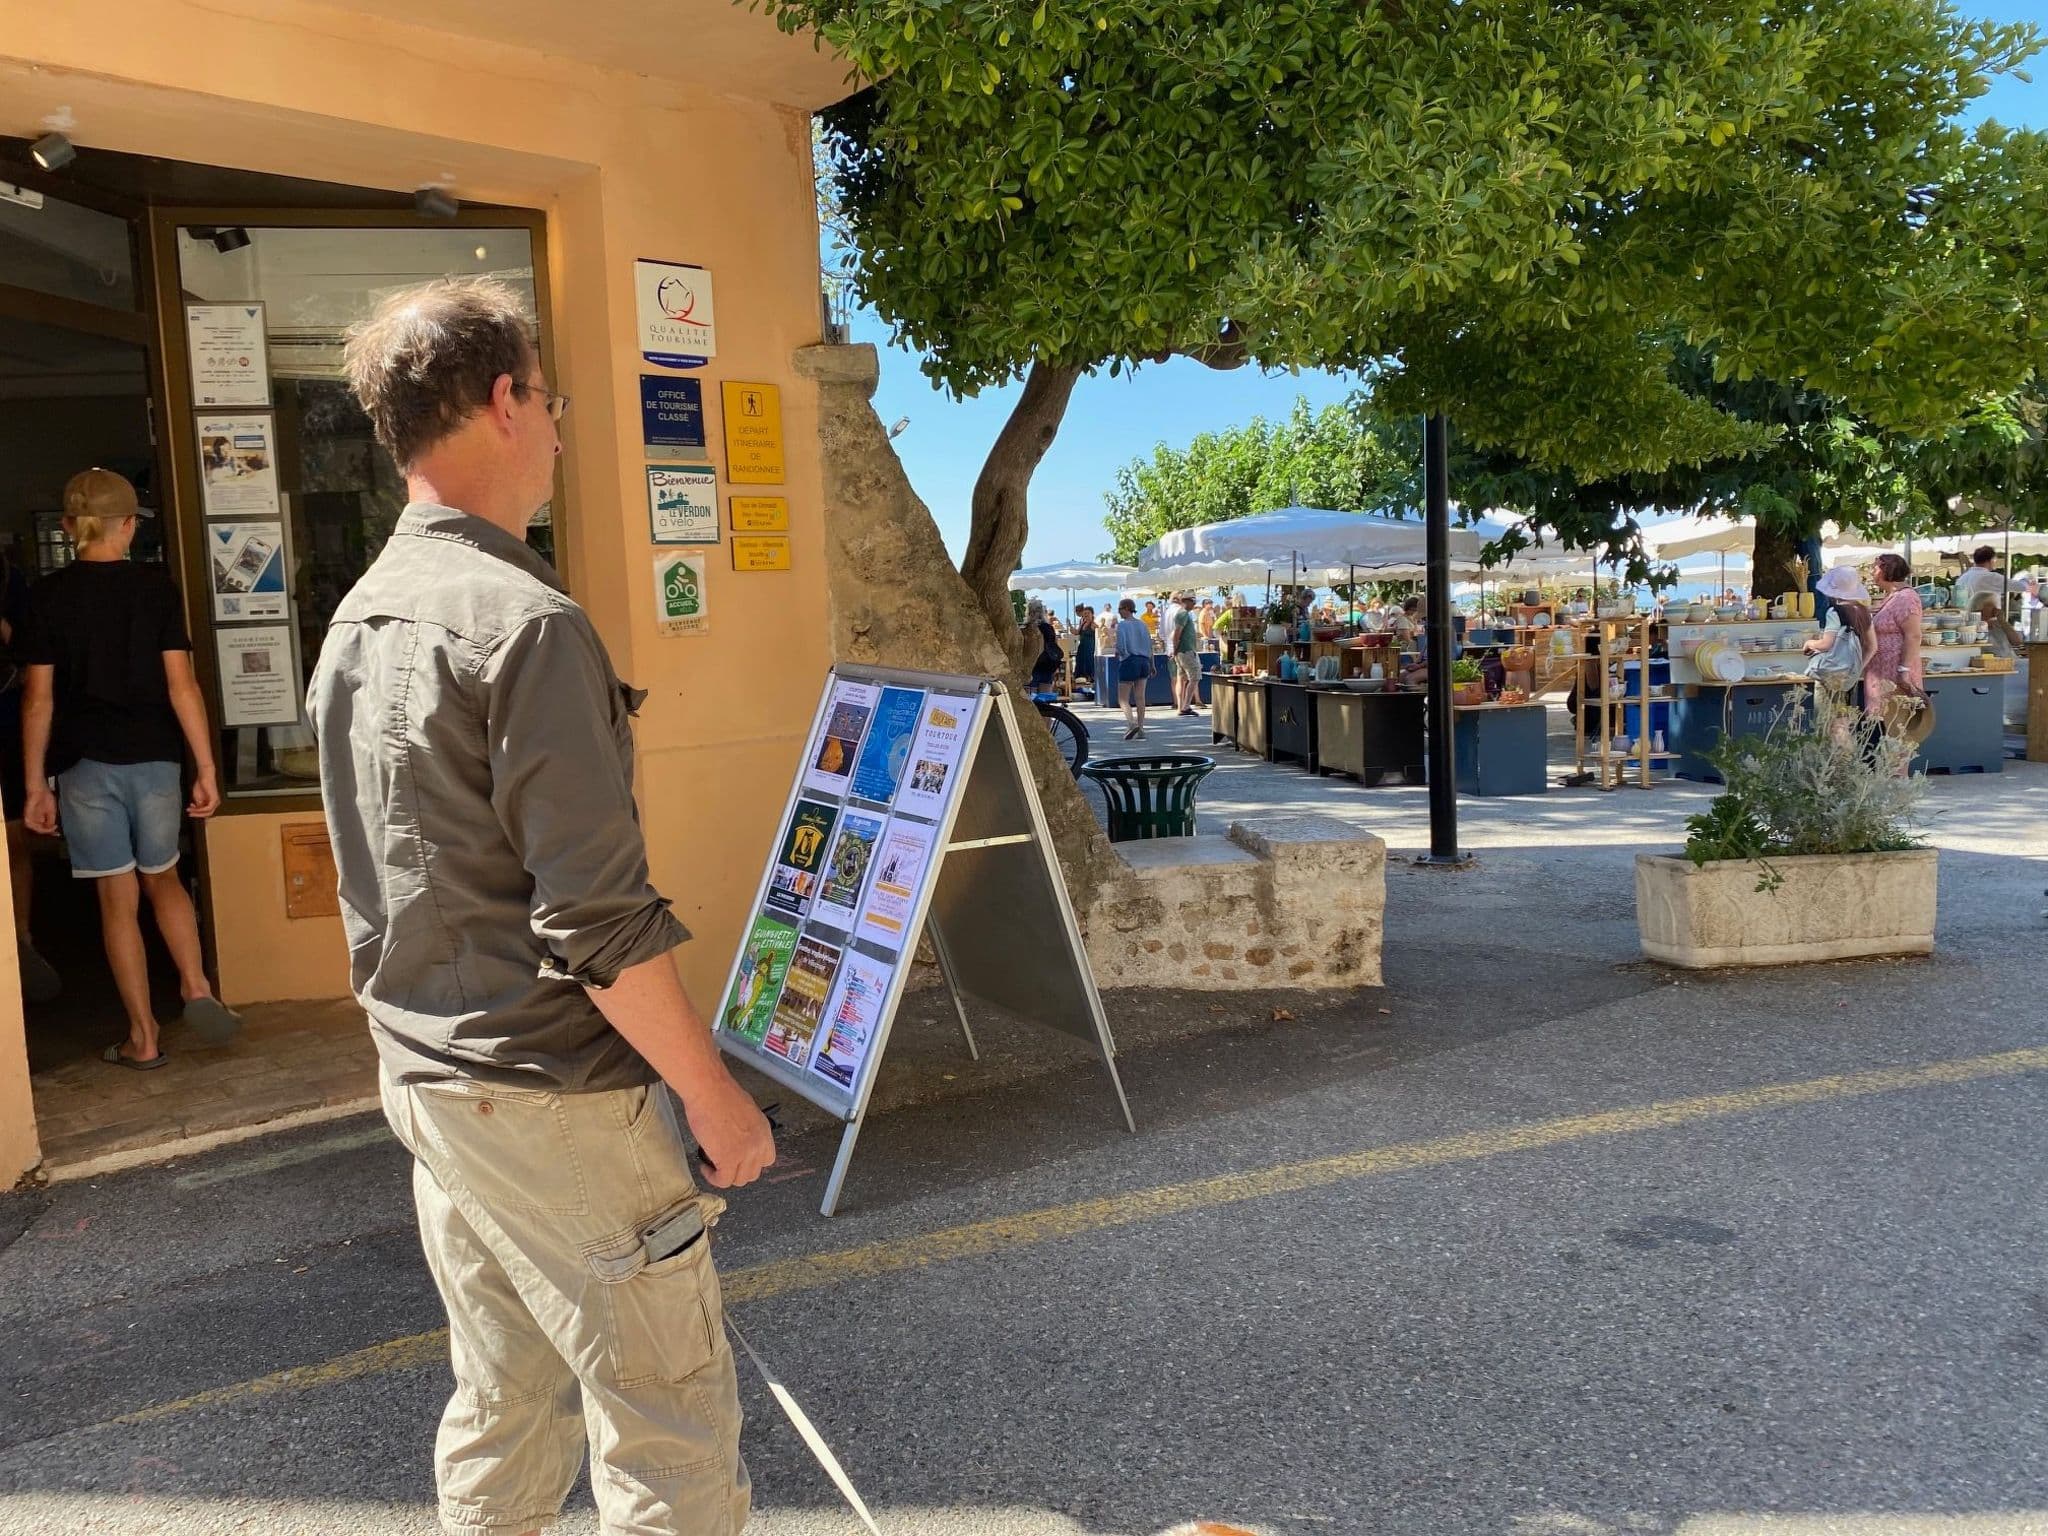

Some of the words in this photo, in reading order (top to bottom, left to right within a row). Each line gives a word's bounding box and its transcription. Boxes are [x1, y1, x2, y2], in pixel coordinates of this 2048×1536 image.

[650, 333, 708, 346] TOURISME
[657, 390, 687, 400] OFFICE
[646, 400, 658, 409] DE
[659, 401, 699, 411] TOURISME
[751, 452, 761, 461] DE
[650, 471, 714, 486] Bienvenue
[677, 505, 711, 518] VERDON
